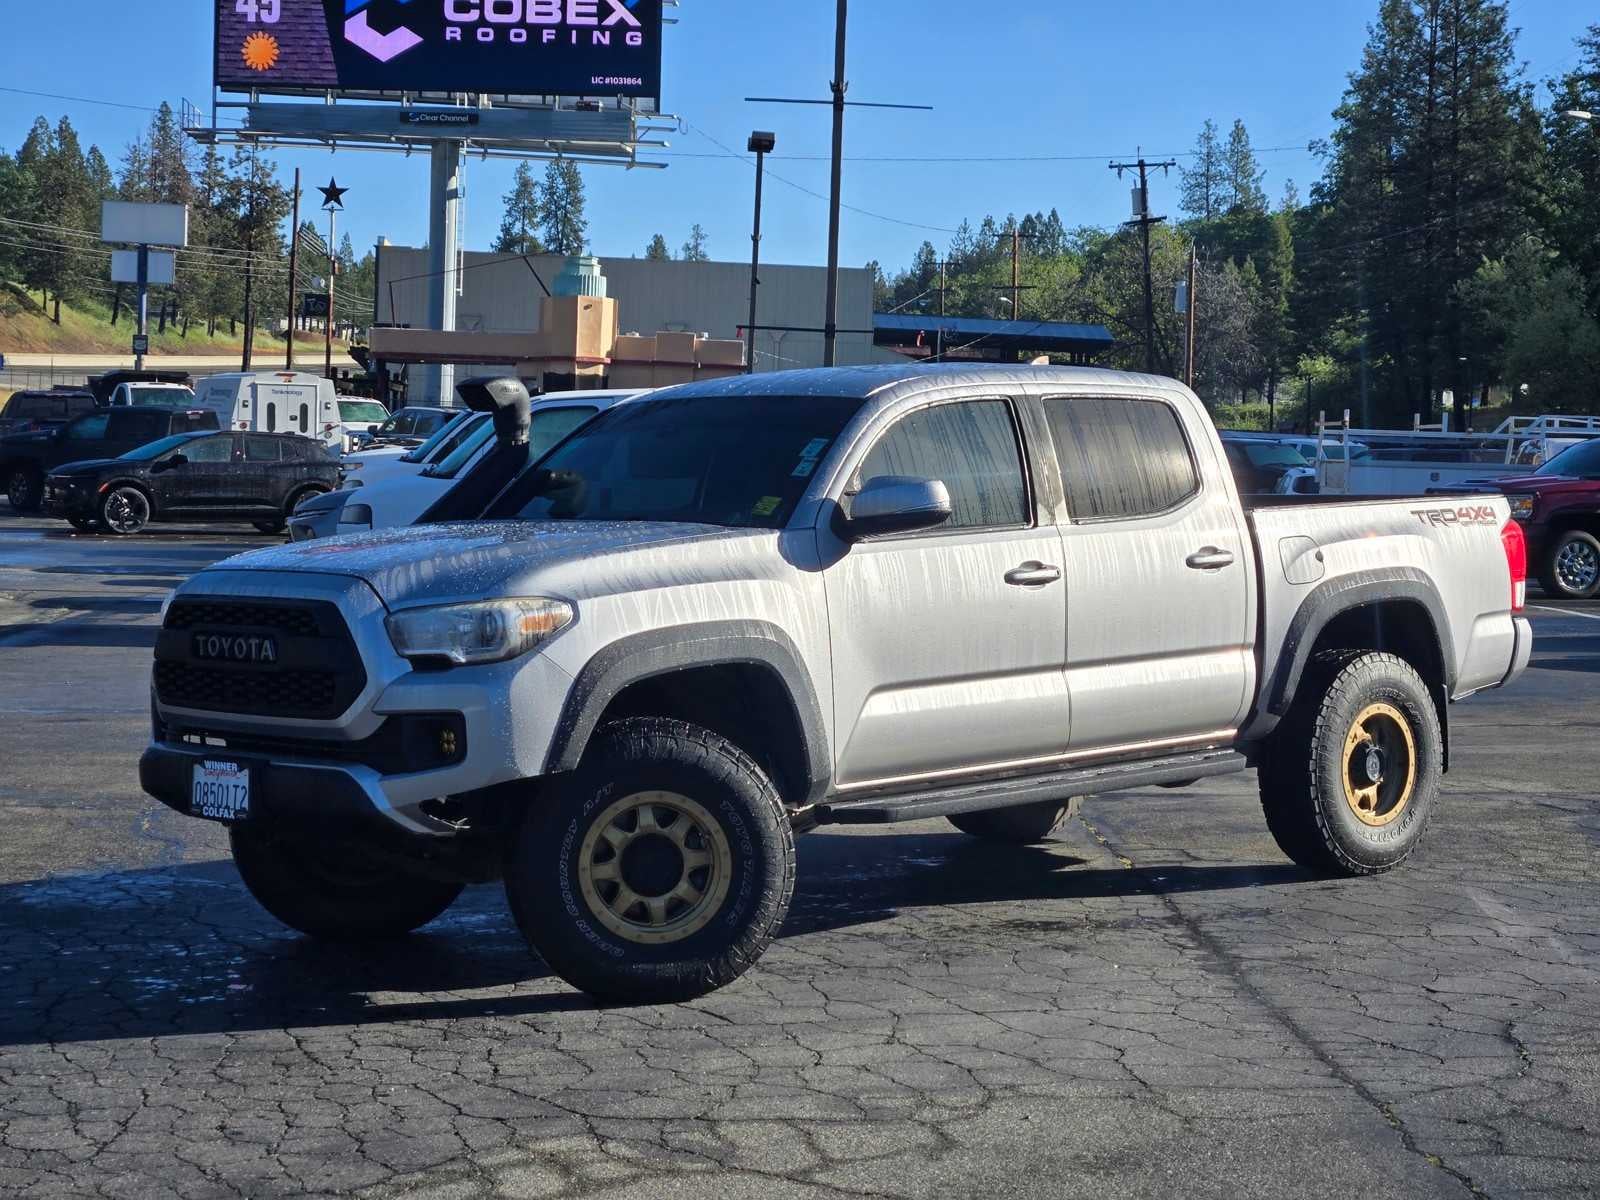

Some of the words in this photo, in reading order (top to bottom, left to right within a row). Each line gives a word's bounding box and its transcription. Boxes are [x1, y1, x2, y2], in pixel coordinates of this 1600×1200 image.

[443, 0, 643, 26] COBEX
[445, 26, 643, 46] ROOFING
[591, 76, 604, 84] LIC
[605, 76, 642, 85] #1031864
[419, 113, 439, 121] Clear
[440, 114, 469, 122] Channel
[196, 635, 275, 661] TOYOTA
[204, 759, 238, 772] WINNER
[195, 780, 248, 810] 08501T2
[202, 806, 236, 820] COLFAX
